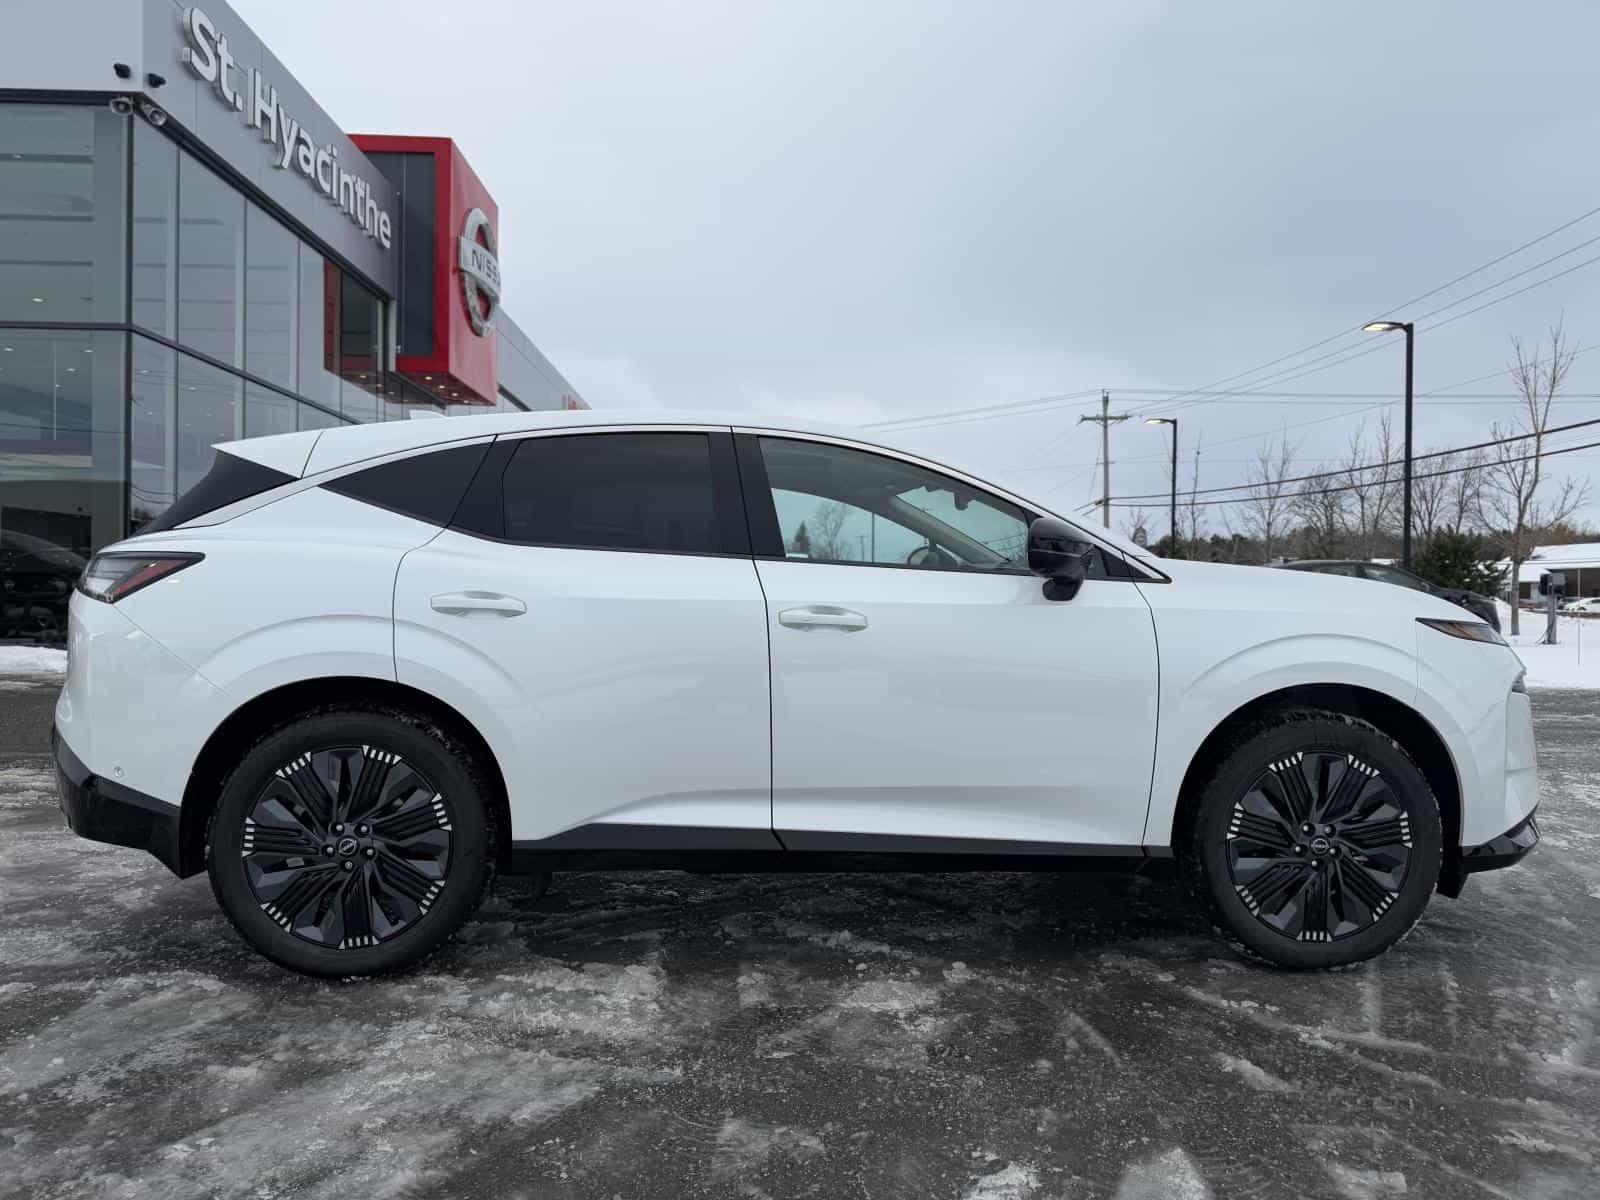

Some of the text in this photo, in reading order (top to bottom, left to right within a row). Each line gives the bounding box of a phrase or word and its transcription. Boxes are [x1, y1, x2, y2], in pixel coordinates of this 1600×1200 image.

[184, 8, 391, 249] St. Hyacinthe
[471, 248, 501, 286] NISS
